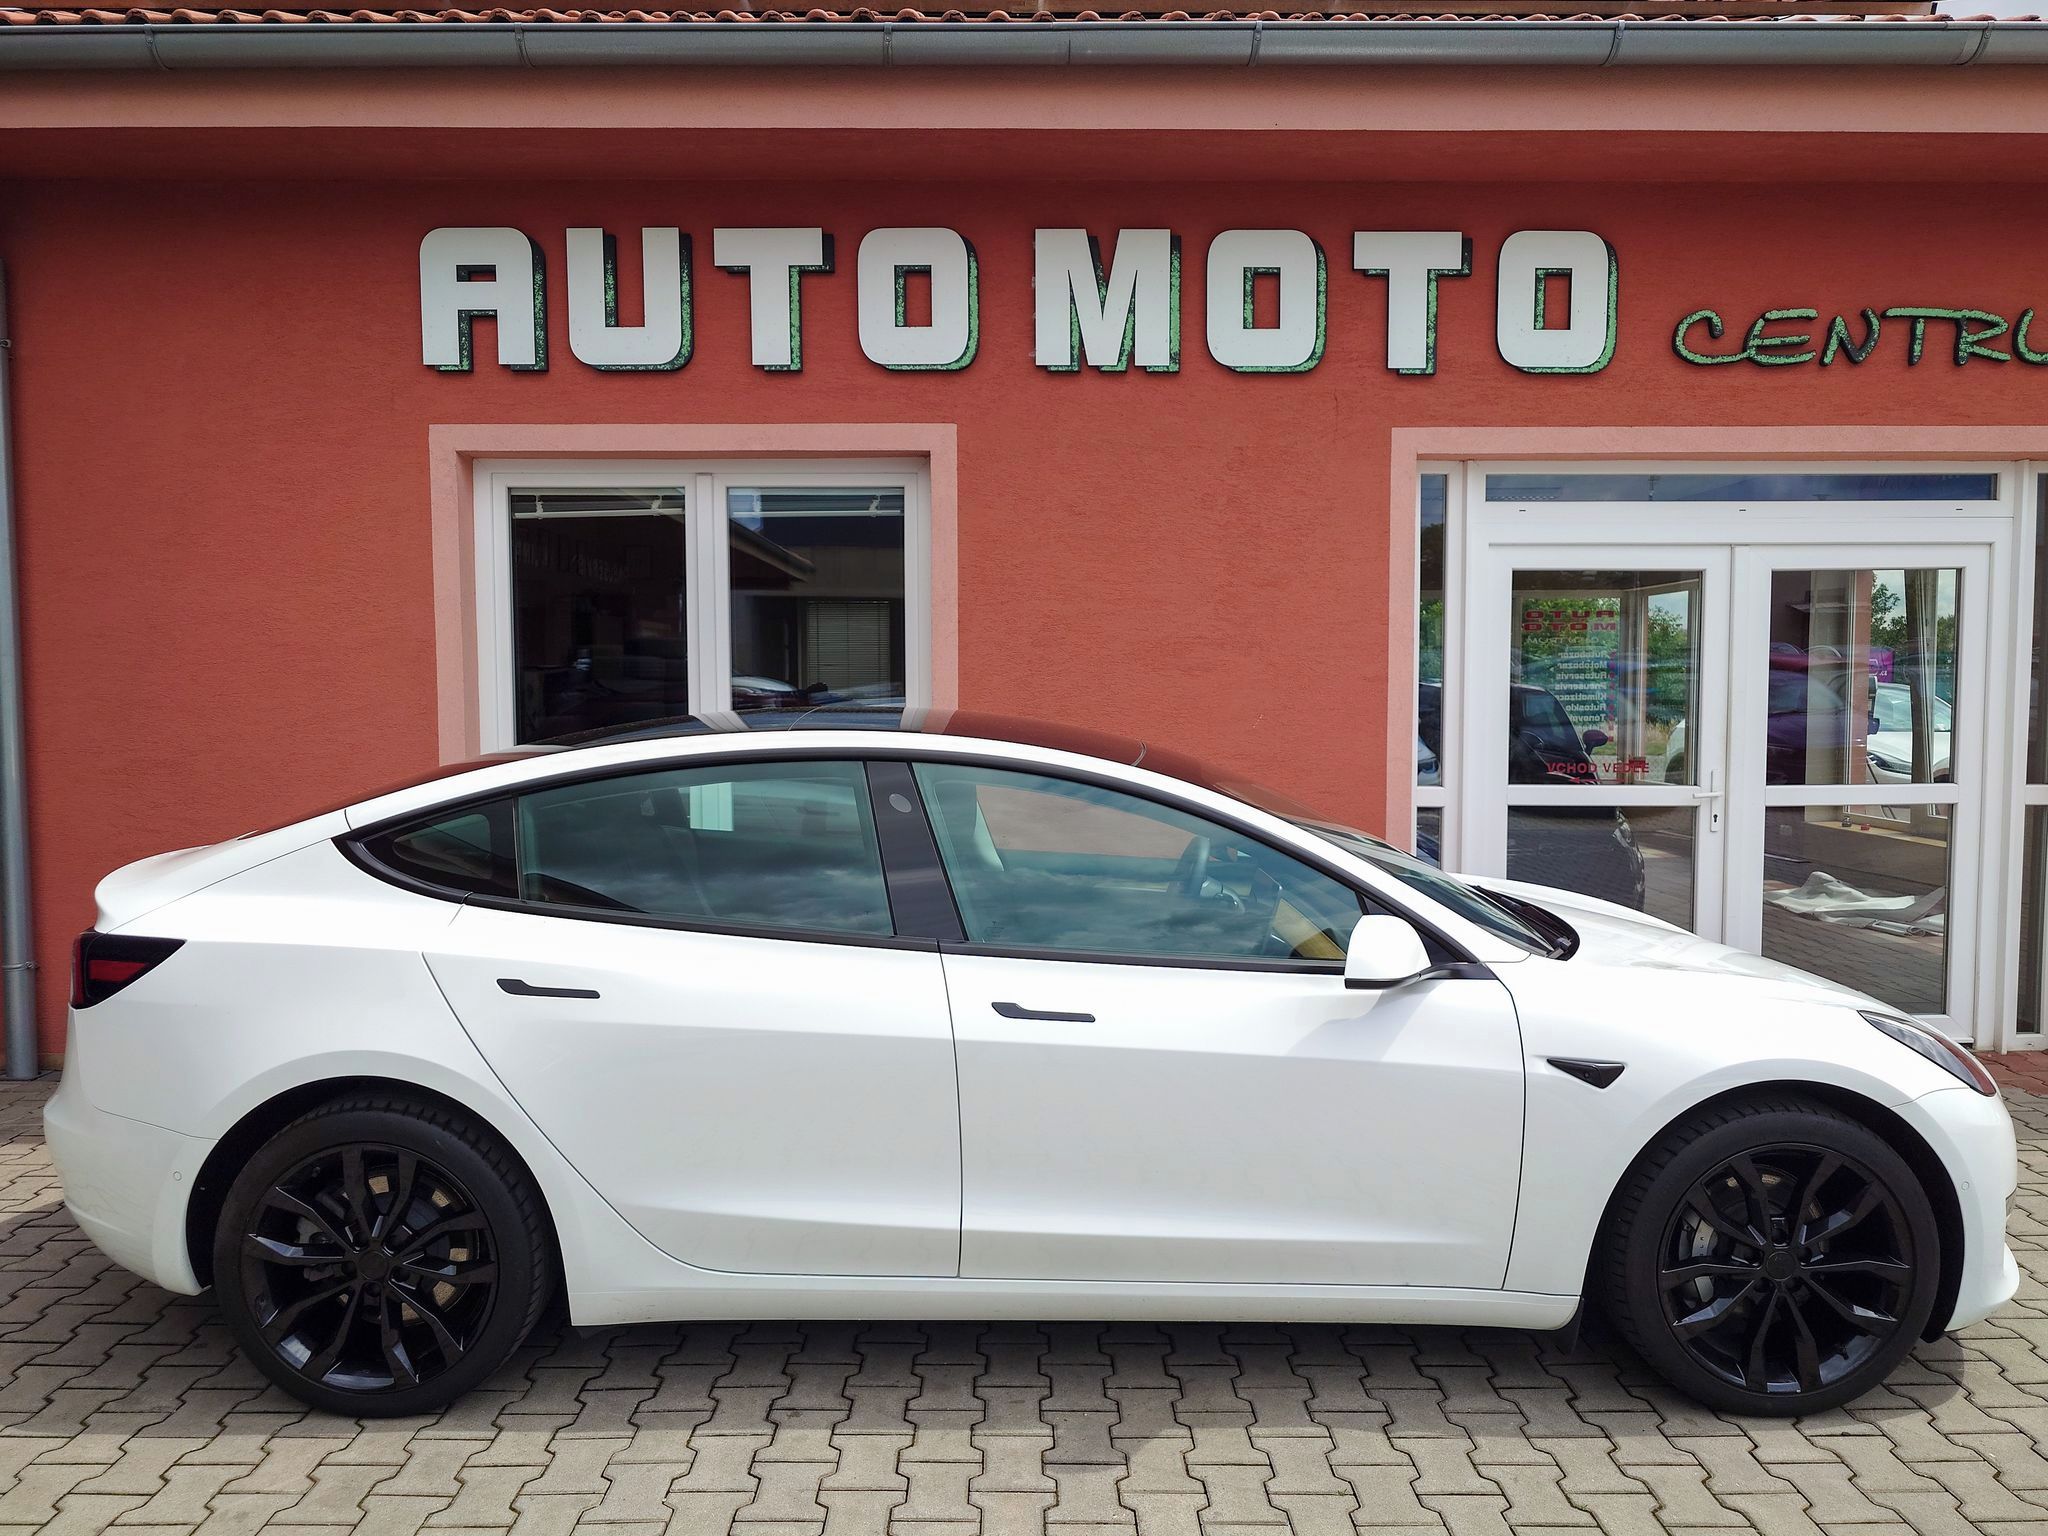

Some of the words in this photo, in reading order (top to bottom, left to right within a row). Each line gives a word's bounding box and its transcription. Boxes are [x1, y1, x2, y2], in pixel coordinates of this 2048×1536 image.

[419, 226, 980, 371] AUTO
[1033, 228, 1618, 374] MOTO
[1672, 306, 2048, 366] CENTRU
[1546, 762, 1598, 774] VCHOD
